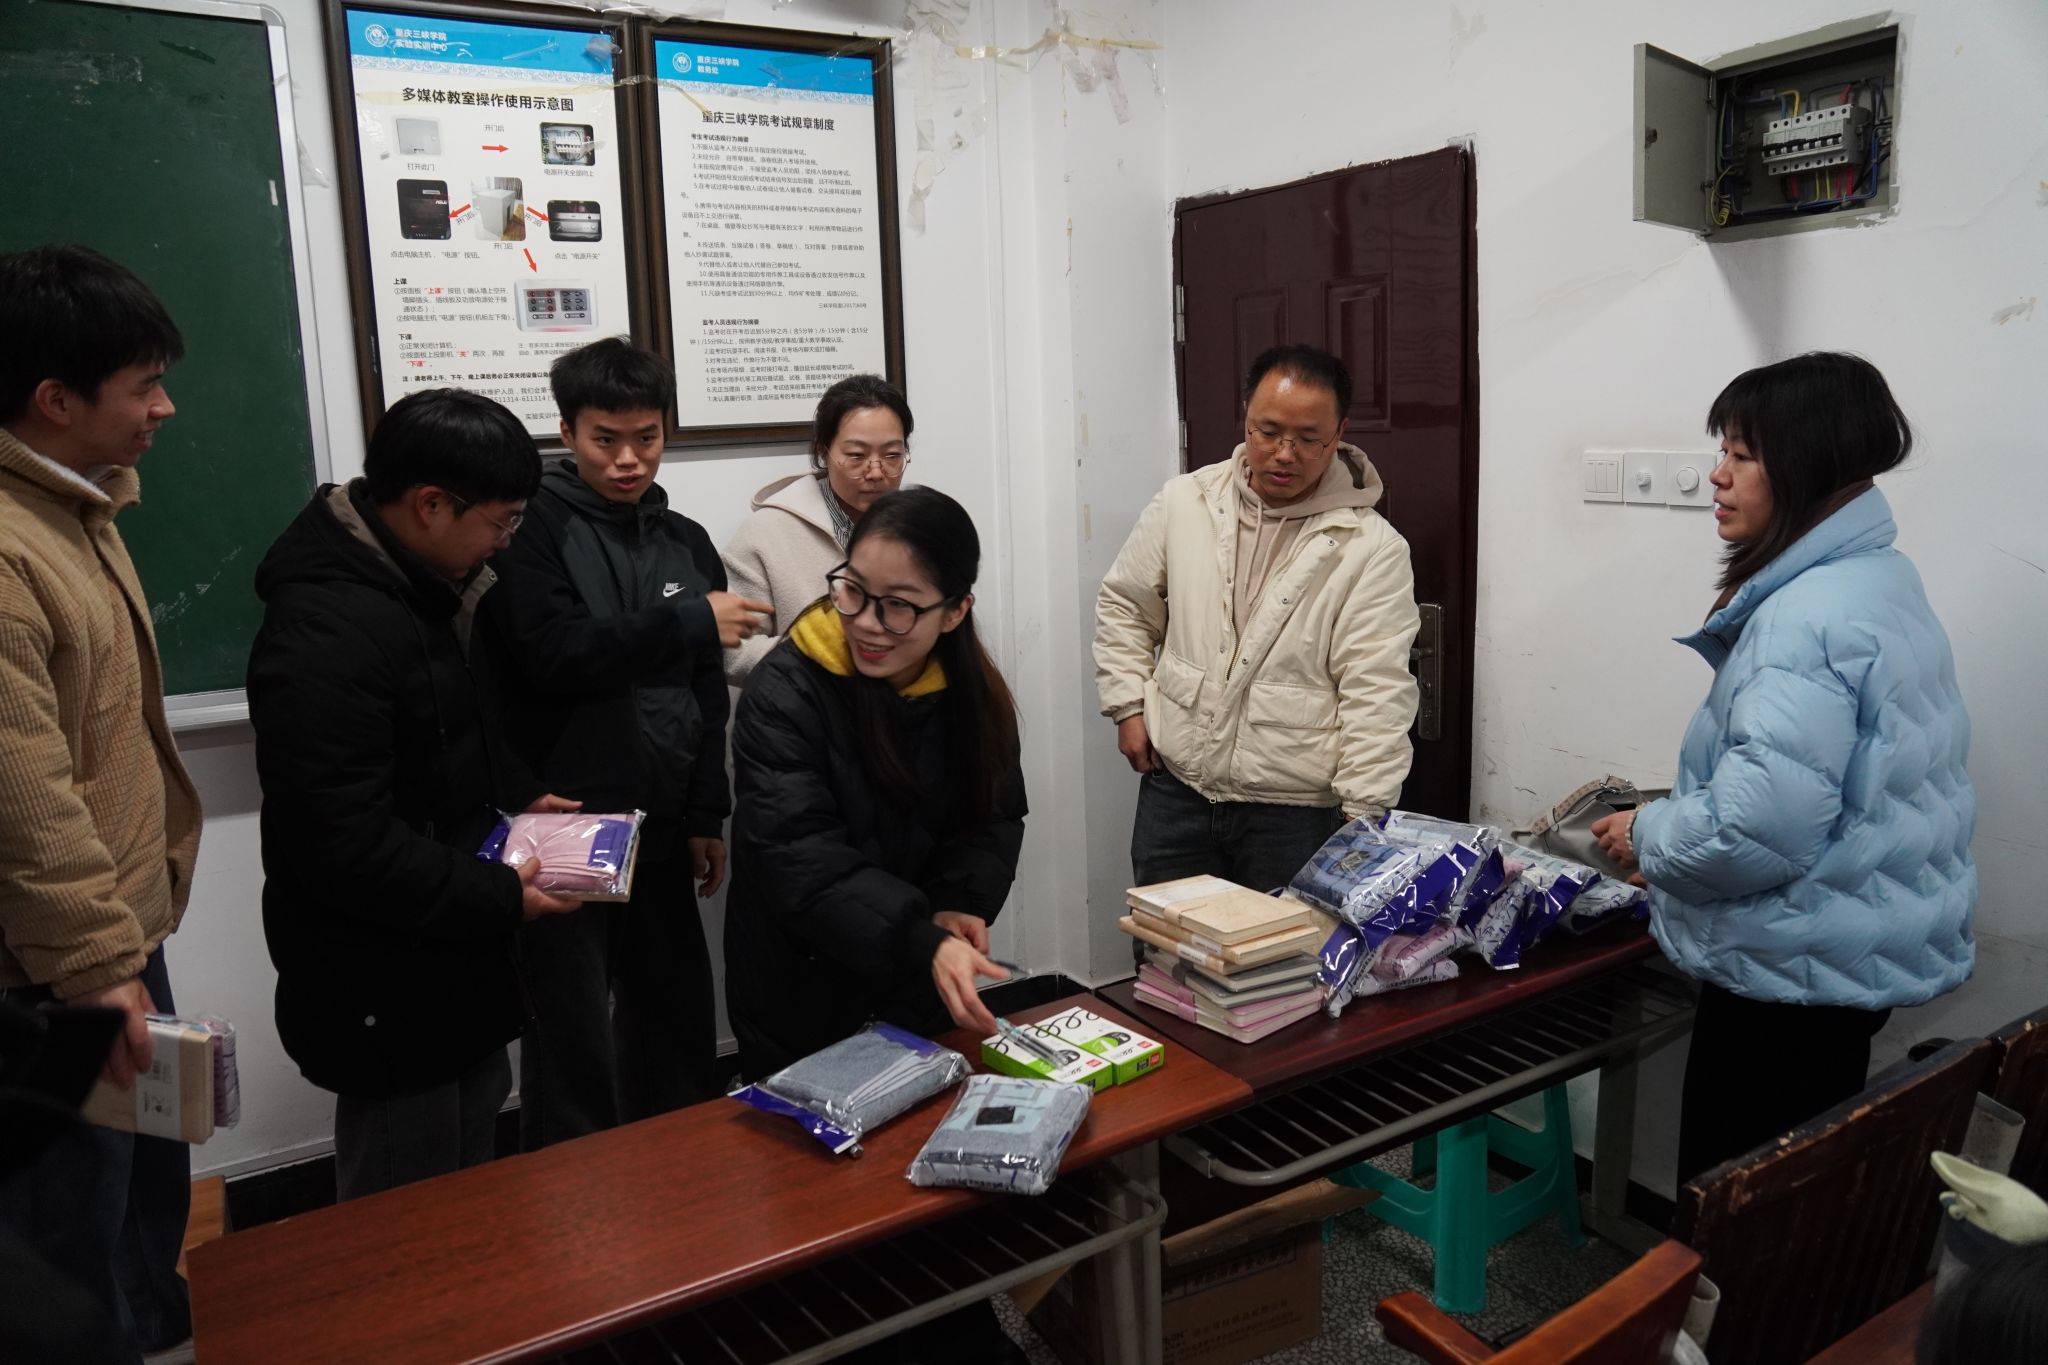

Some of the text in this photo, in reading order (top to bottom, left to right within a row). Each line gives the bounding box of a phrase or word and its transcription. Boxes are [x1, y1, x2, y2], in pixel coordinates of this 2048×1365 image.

[697, 55, 739, 67] 重庆三峡学院
[697, 65, 719, 75] 教务处
[402, 87, 574, 112] 多媒体教室操作使用示意图
[702, 110, 835, 131] 重庆三峡学院考试规章制度
[407, 162, 435, 172] 打开此门
[398, 333, 412, 341] 下课
[665, 582, 679, 591] NIKE
